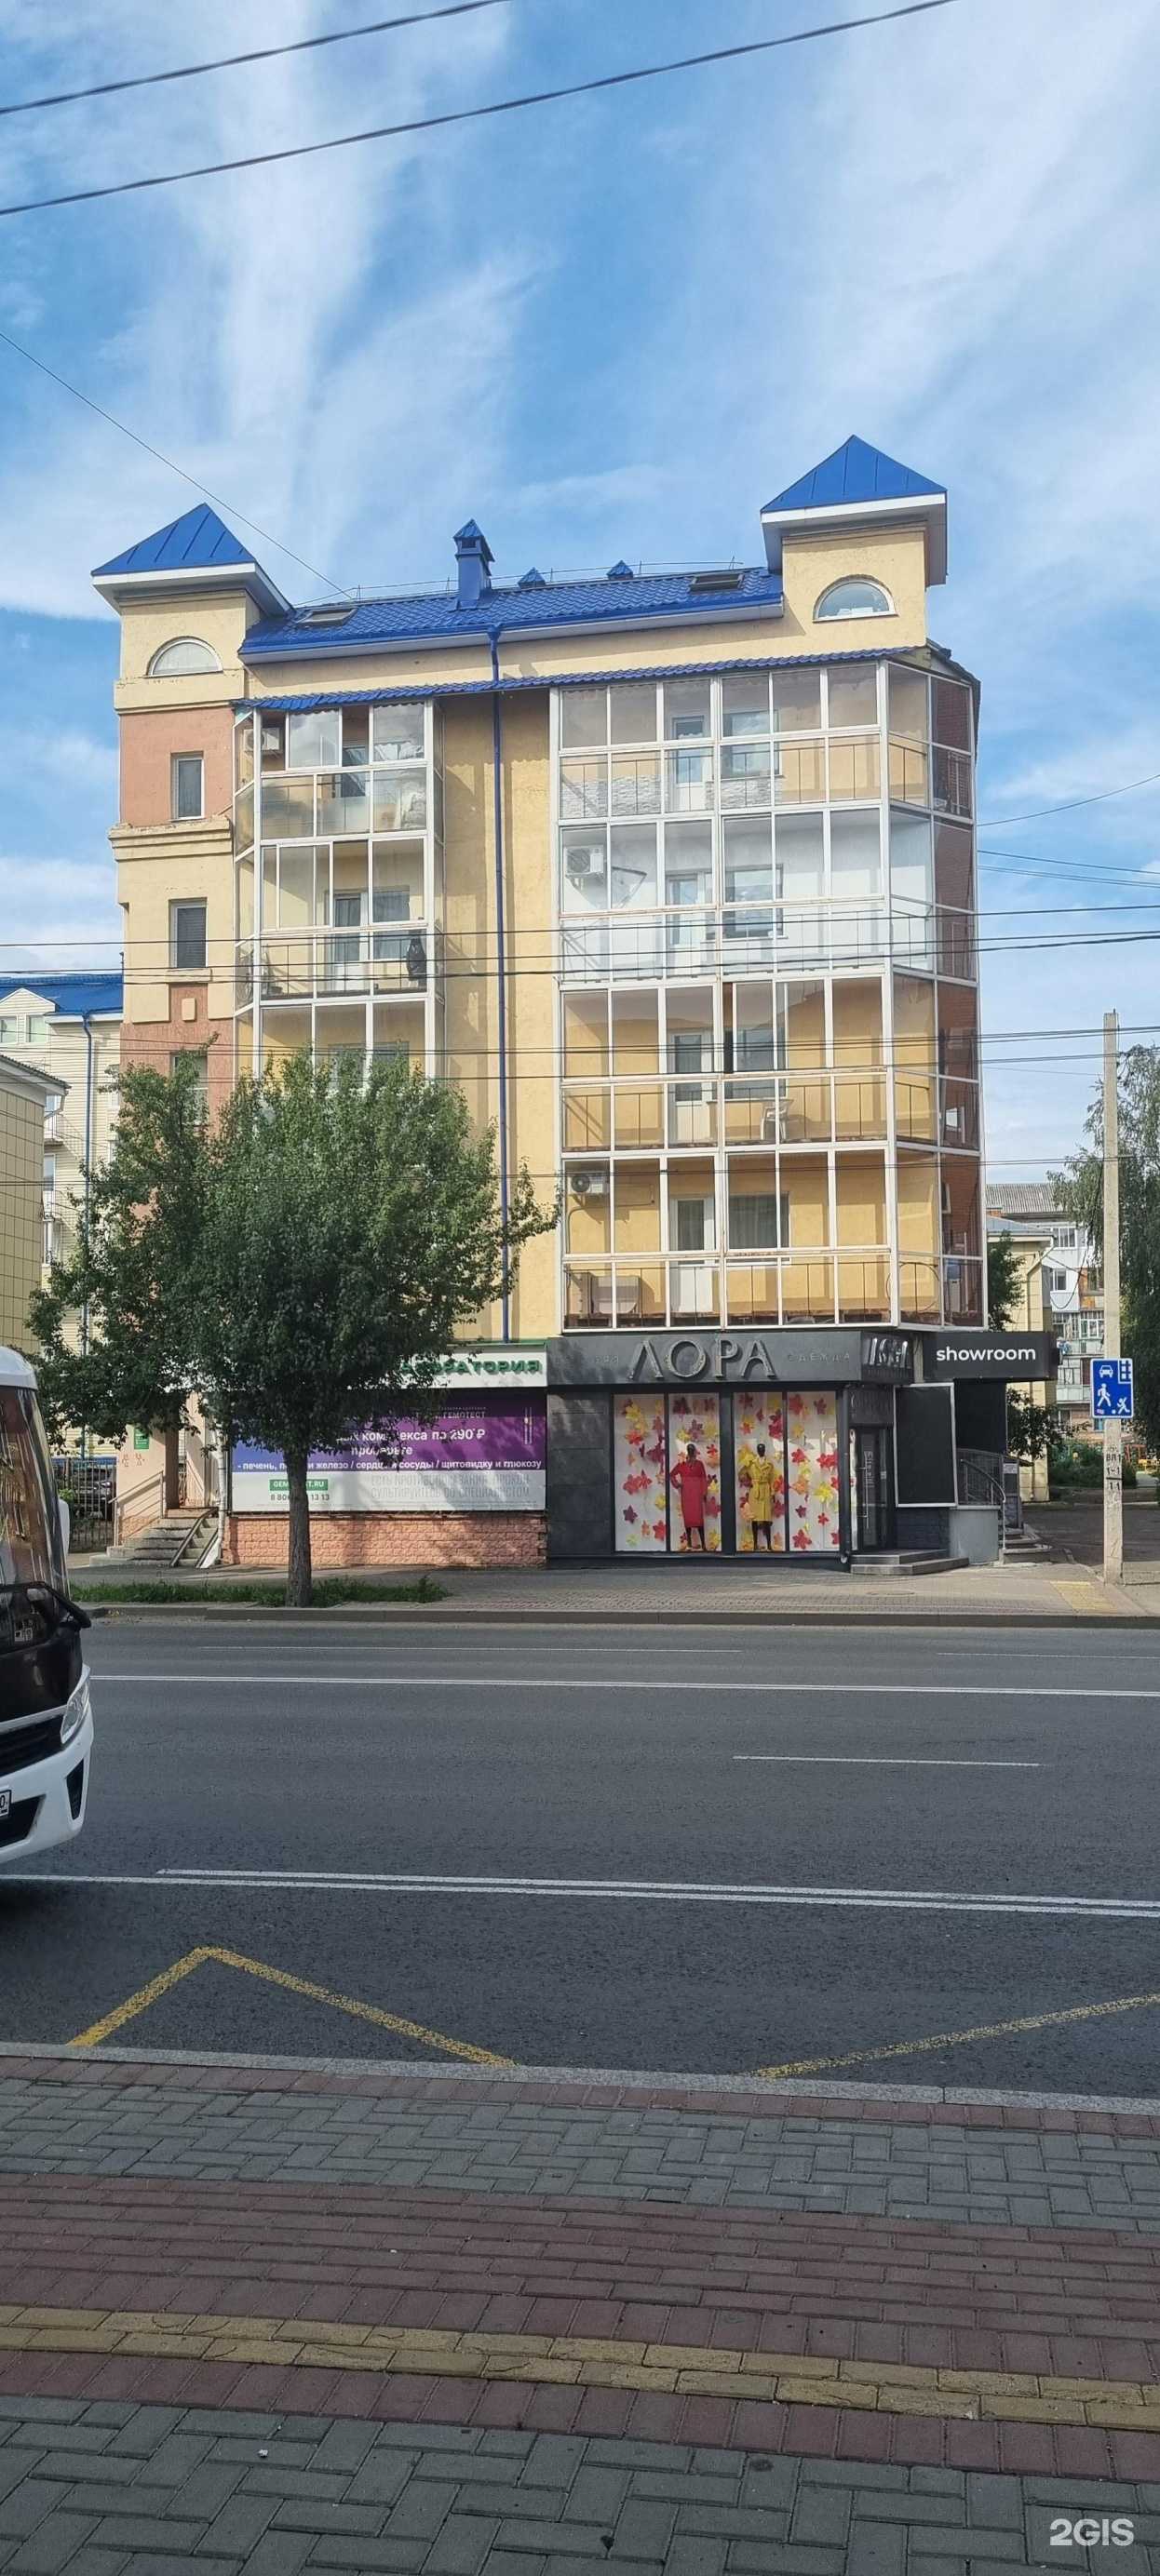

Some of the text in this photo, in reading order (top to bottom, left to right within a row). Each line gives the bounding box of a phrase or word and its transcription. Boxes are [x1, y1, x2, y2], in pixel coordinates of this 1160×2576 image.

[936, 1346, 1036, 1361] showroom
[361, 1431, 427, 1442] комекса
[243, 1462, 277, 1470] печень,
[399, 1461, 434, 1470] сосуды
[441, 1461, 493, 1470] щитовидку
[504, 1460, 542, 1469] глюкозу
